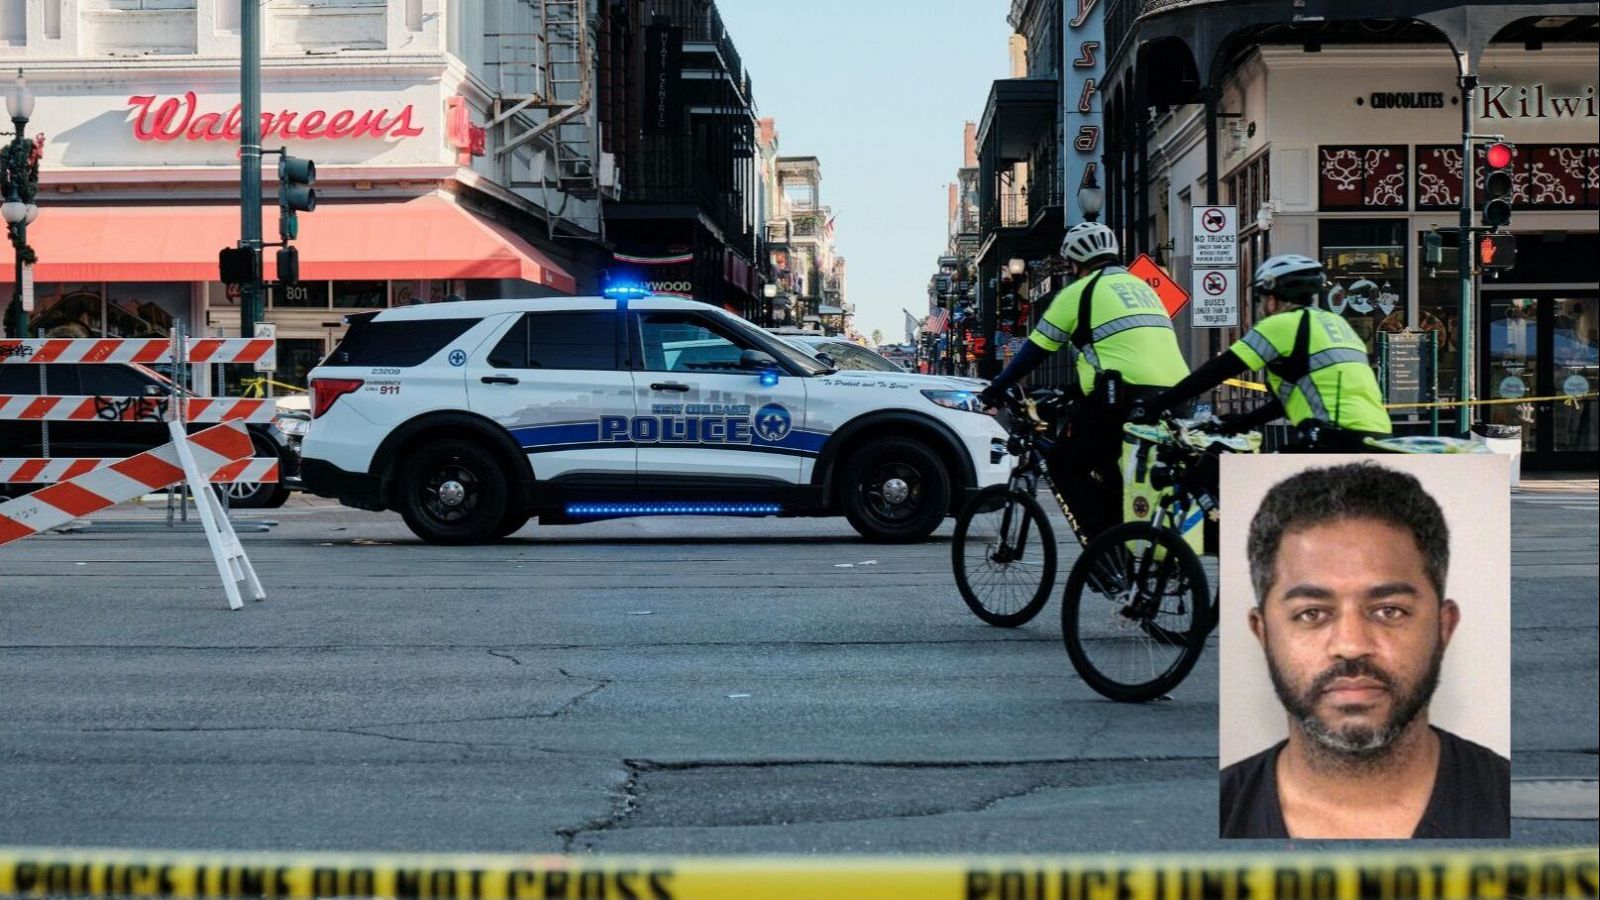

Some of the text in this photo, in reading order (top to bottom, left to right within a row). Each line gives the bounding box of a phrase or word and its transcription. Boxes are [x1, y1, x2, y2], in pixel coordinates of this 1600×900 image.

[1371, 92, 1444, 108] CHOCOLATES
[640, 281, 692, 292] LYWOOD
[287, 287, 308, 300] 801
[380, 386, 400, 395] 911
[652, 404, 751, 416] NEW ORLEANS
[599, 415, 752, 444] POLICE
